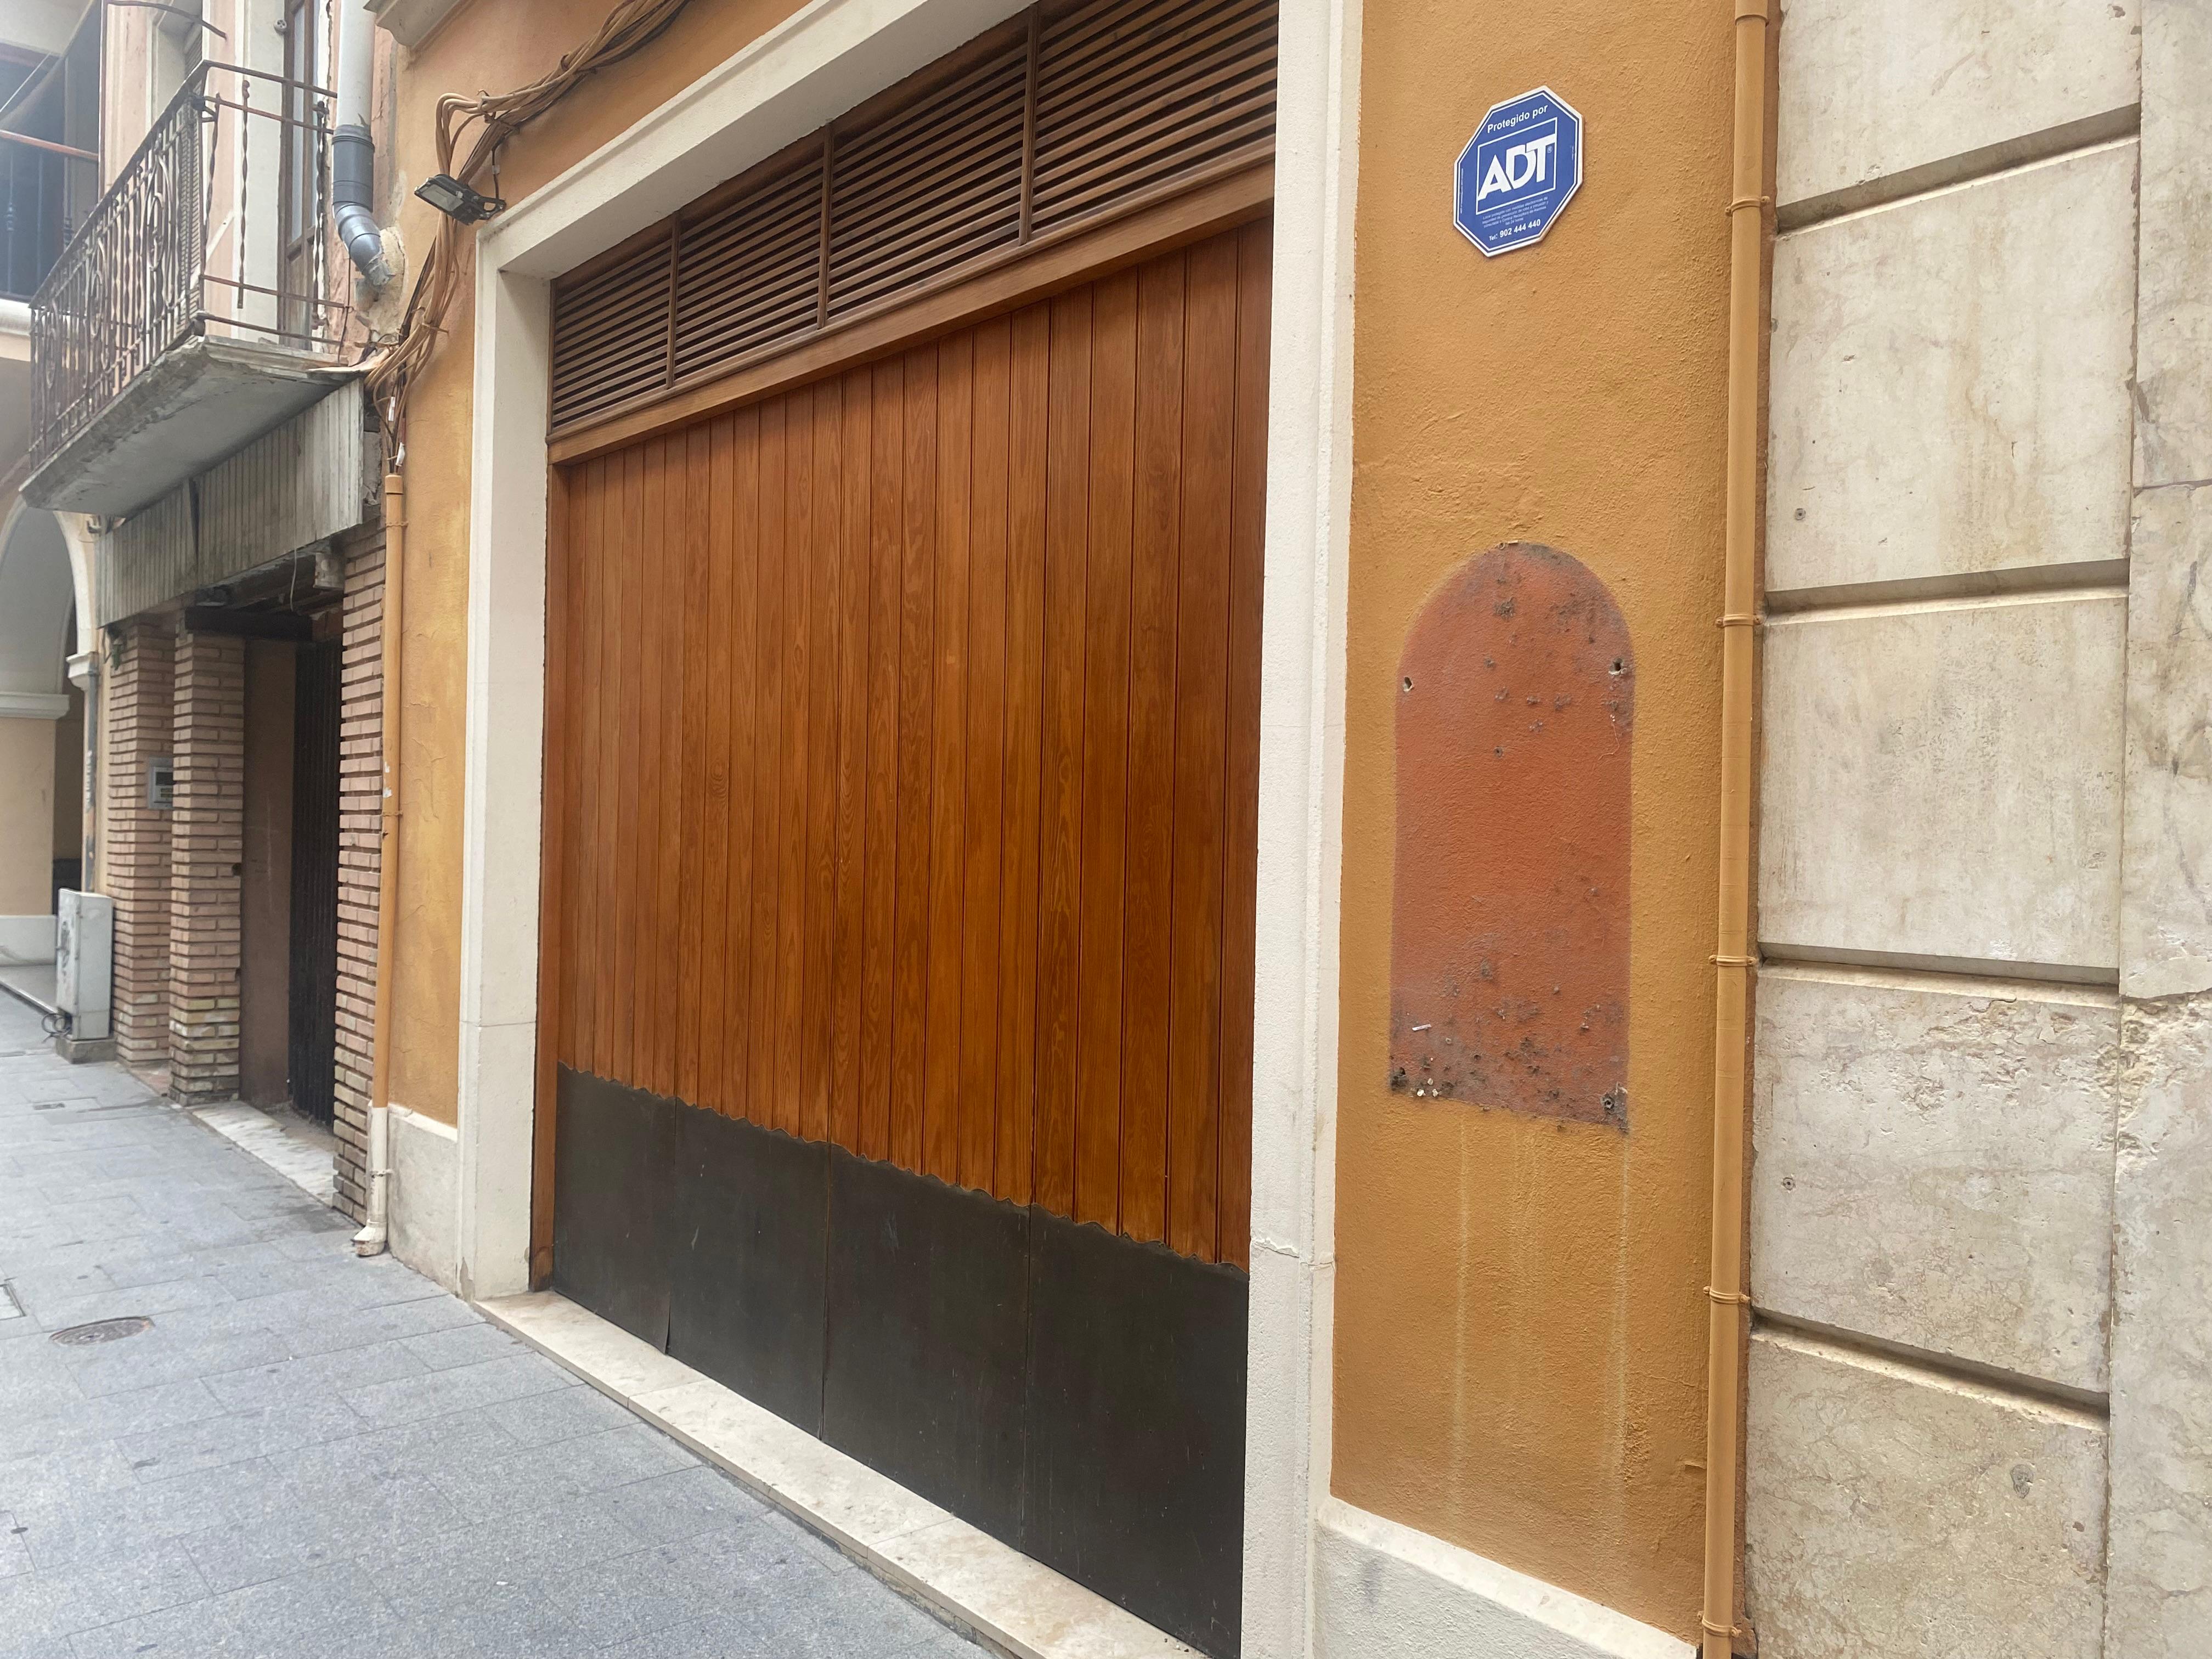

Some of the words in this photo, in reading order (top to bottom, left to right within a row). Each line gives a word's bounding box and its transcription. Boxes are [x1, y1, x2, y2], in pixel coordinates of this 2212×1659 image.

[1487, 111, 1530, 133] Protegido
[1532, 105, 1548, 119] por
[1478, 133, 1557, 201] ADT
[1499, 228, 1513, 238] 902
[1514, 223, 1526, 233] 444
[1528, 218, 1541, 228] 440
